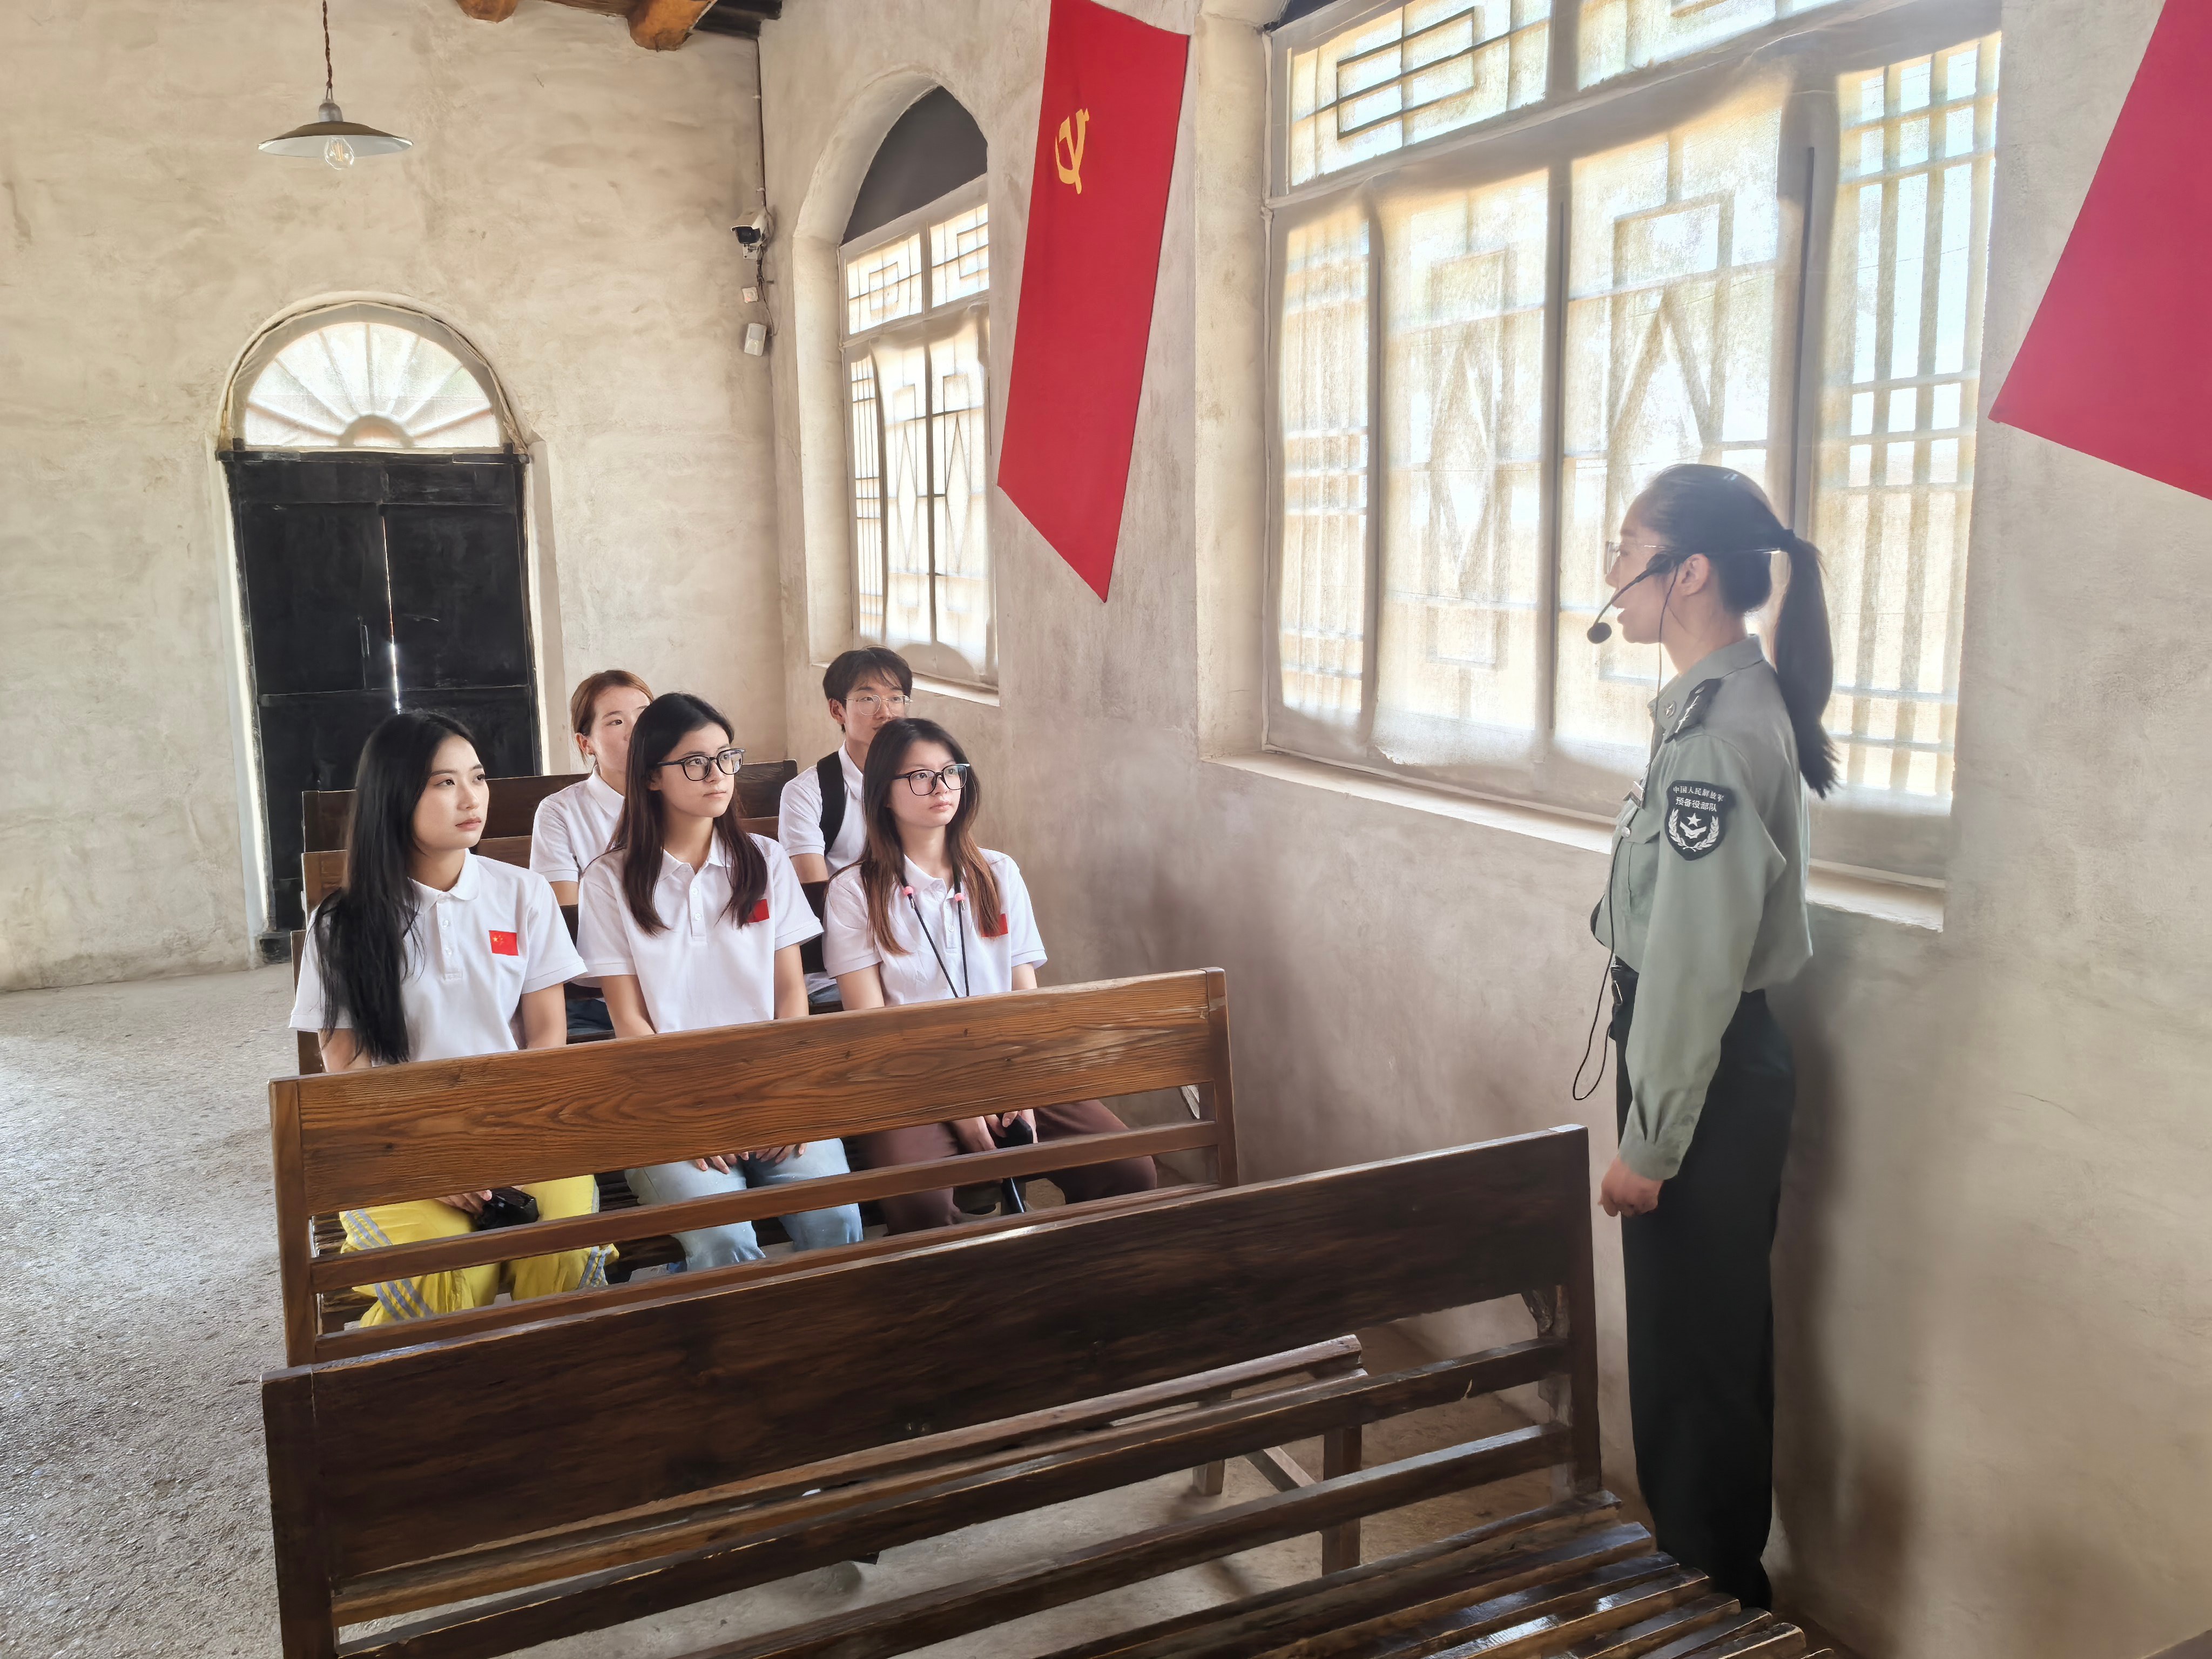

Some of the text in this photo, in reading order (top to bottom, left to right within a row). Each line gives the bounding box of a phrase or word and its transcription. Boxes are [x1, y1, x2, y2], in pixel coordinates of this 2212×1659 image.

[1676, 797, 1716, 812] 预备役部队
